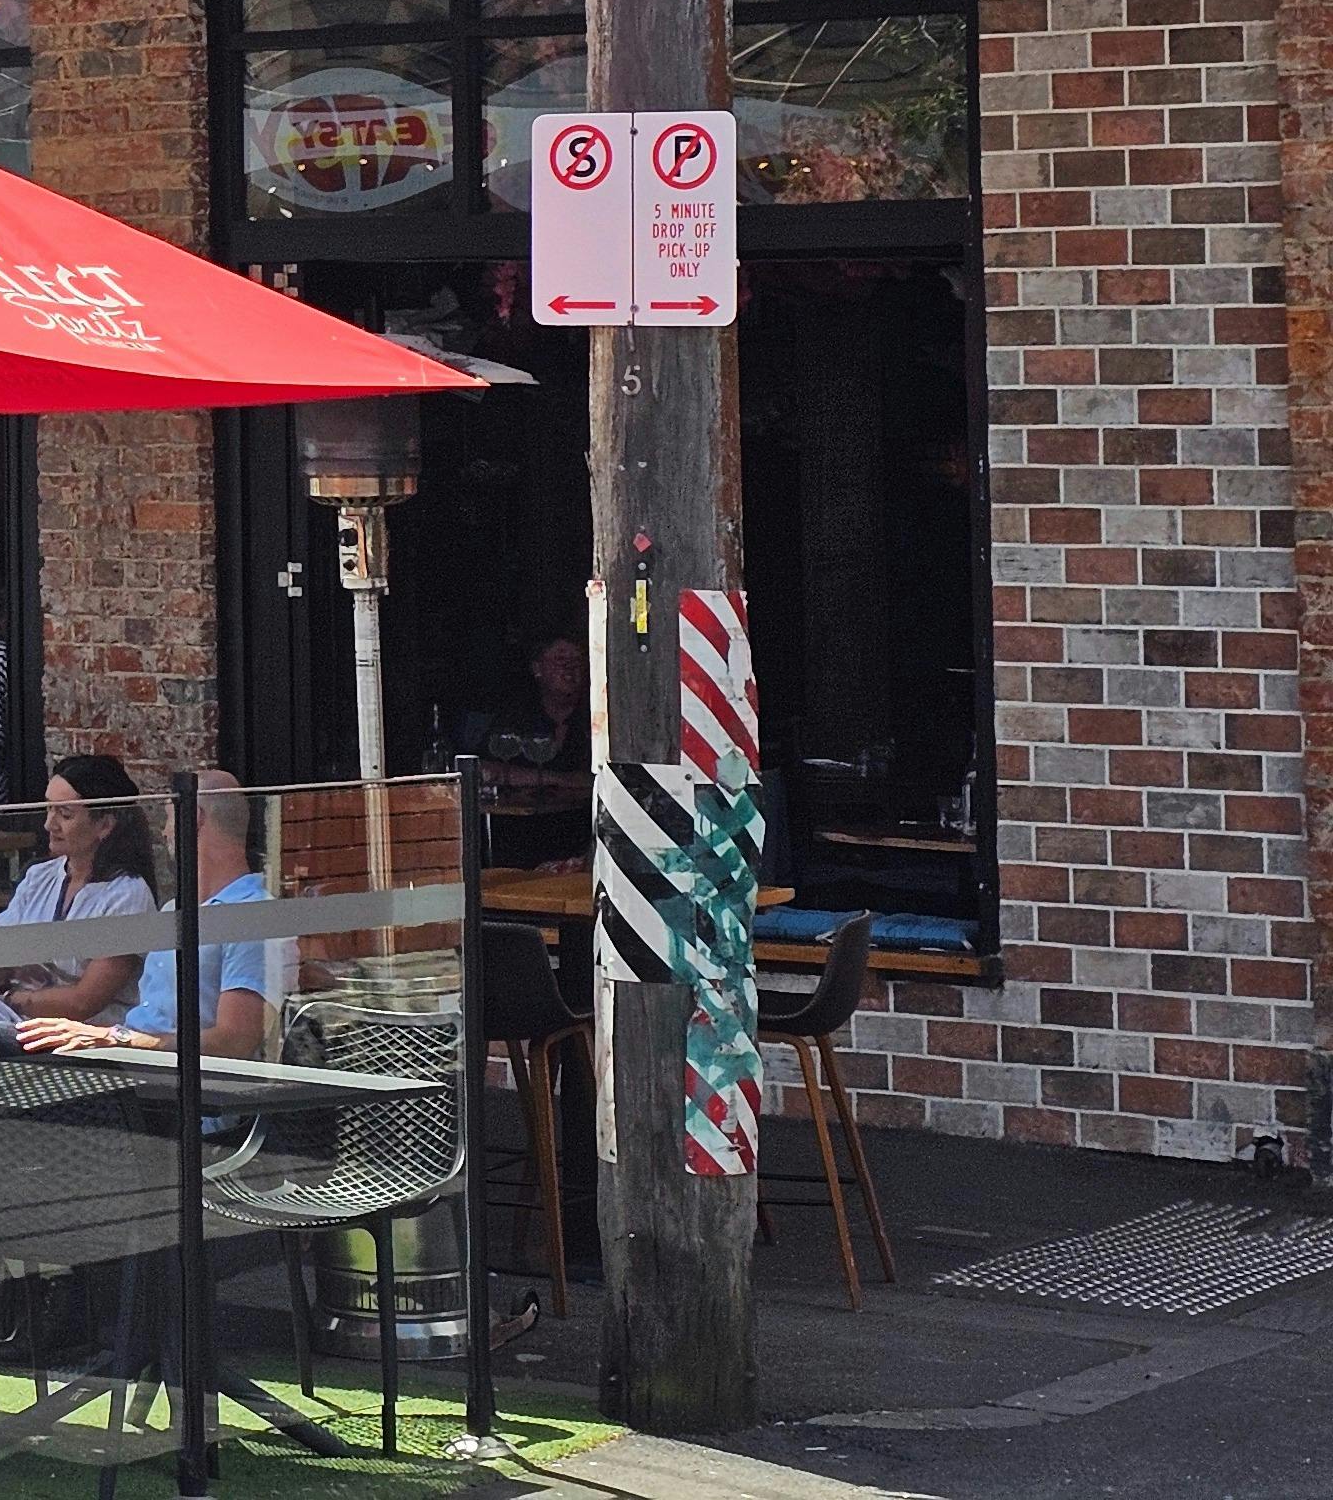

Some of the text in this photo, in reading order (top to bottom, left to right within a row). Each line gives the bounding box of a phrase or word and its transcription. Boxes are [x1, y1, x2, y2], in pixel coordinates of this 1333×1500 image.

[654, 203, 715, 219] 5 MINUTE
[652, 223, 718, 239] DROP OFF
[658, 242, 711, 258] PICK-UP
[669, 262, 701, 278] ONLY
[620, 365, 642, 396] 5
